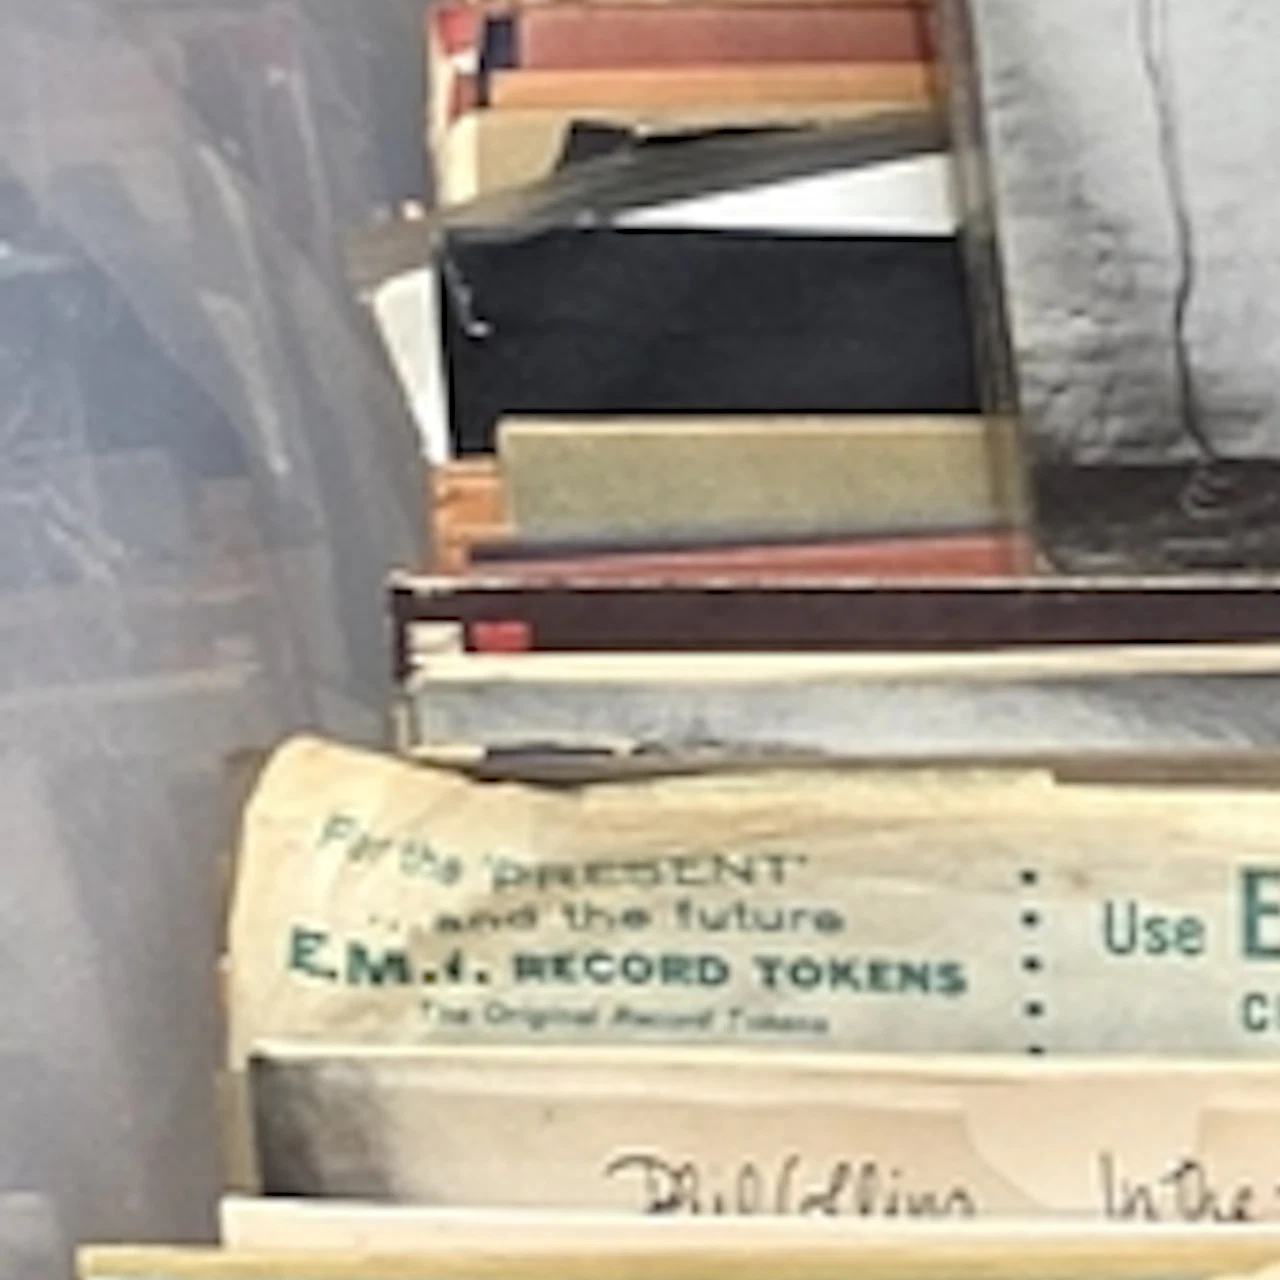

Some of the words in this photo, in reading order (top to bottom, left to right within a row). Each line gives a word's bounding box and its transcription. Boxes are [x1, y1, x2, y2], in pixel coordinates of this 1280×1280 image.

[561, 900, 650, 933] the
[677, 898, 846, 933] future
[1104, 901, 1205, 957] Use
[512, 951, 729, 988] RECORD
[754, 955, 968, 998] TOKENS
